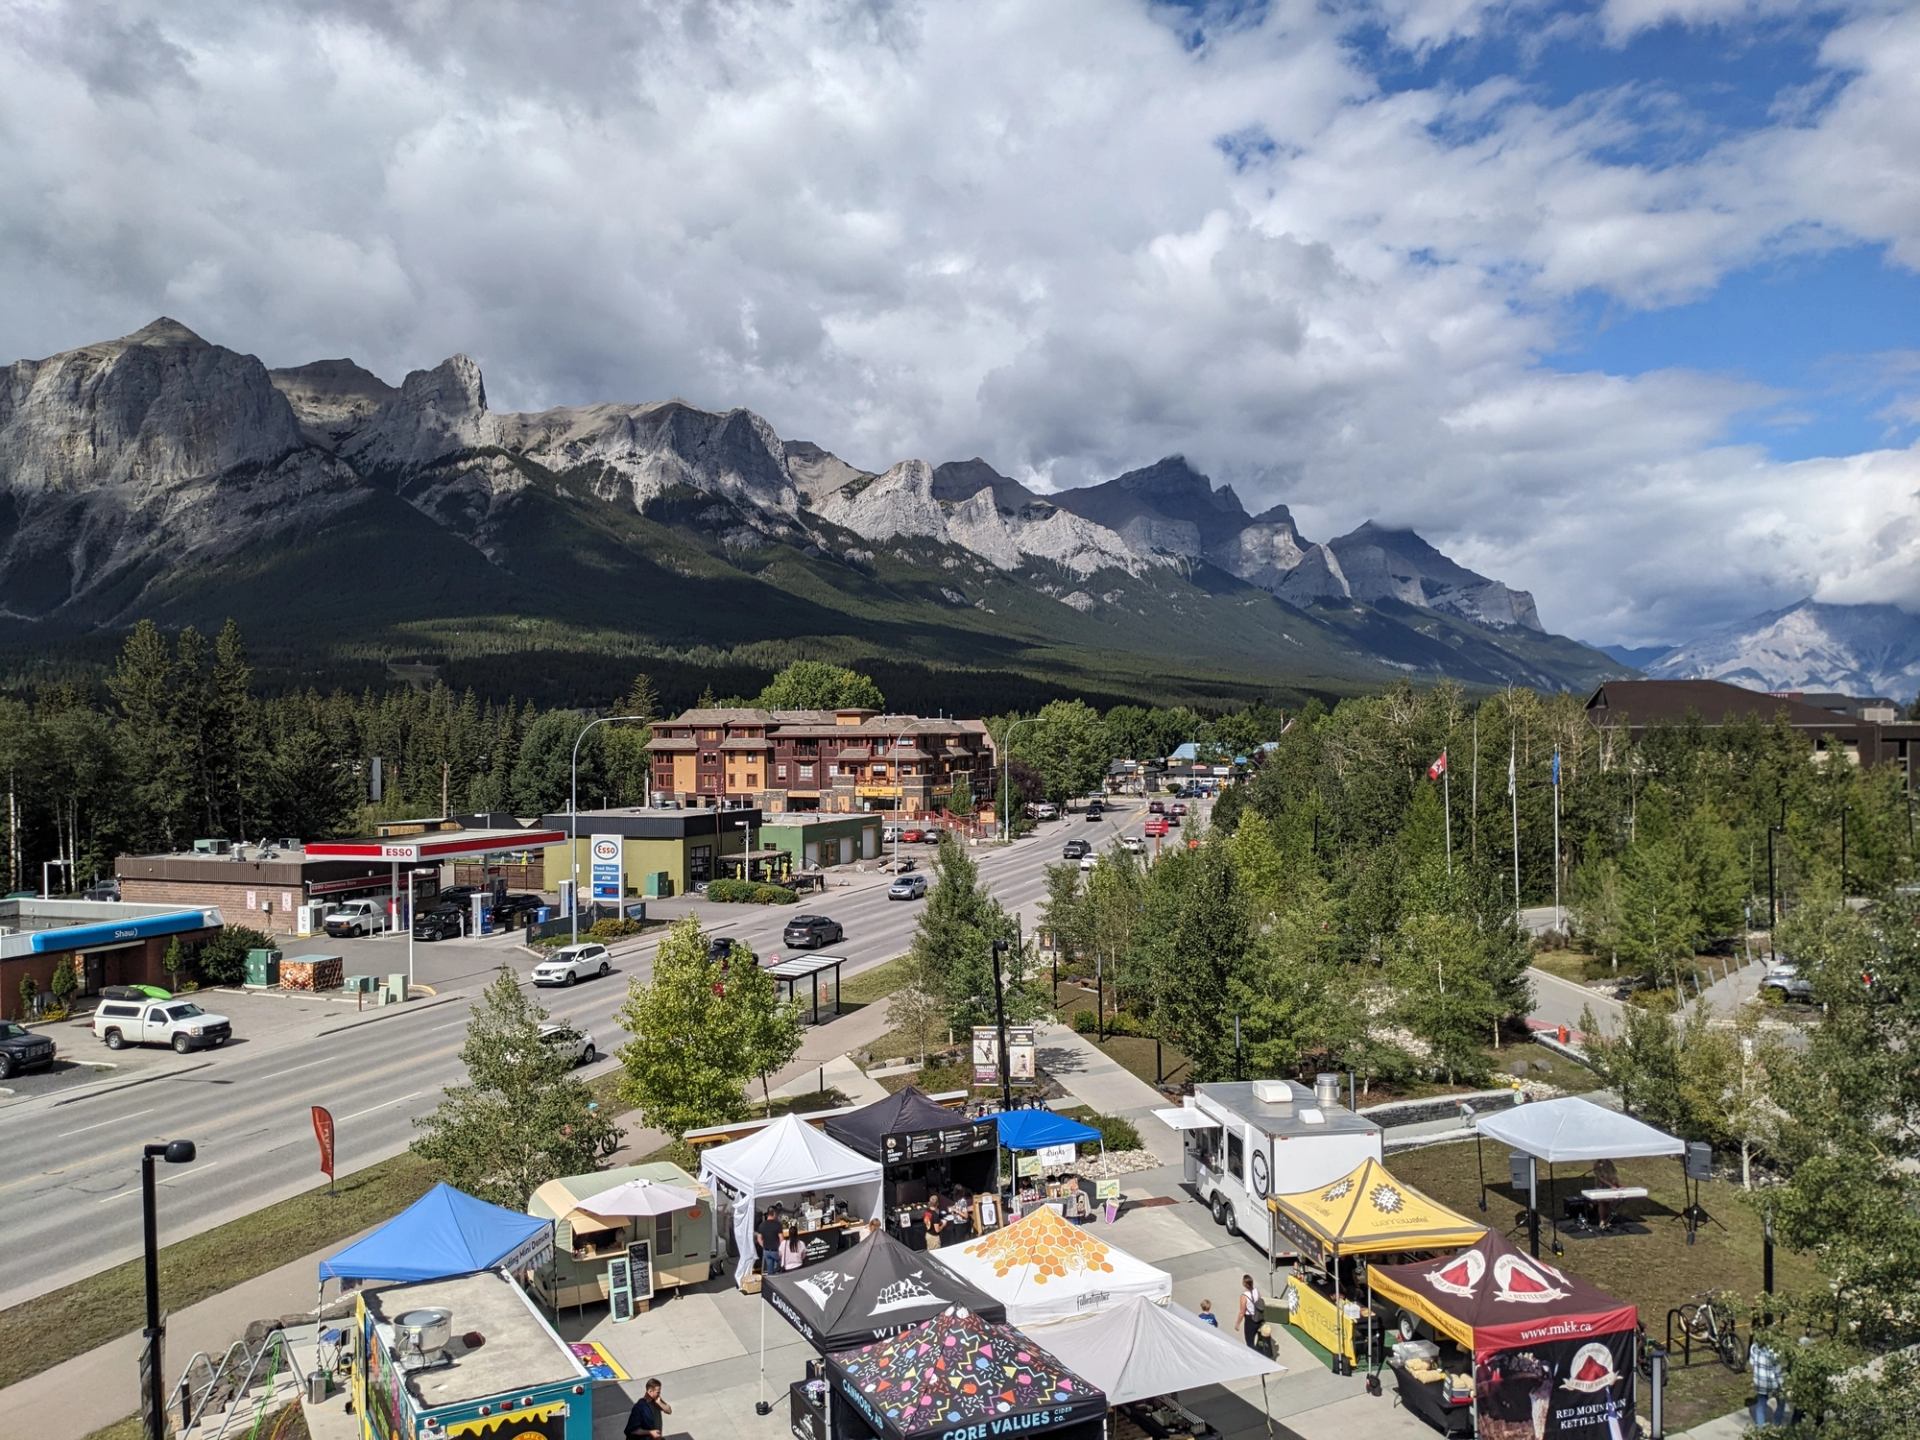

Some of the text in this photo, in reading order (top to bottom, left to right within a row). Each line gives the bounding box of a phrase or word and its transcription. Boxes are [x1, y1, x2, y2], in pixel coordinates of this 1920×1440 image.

[386, 848, 413, 857] ESSO
[598, 845, 615, 854] Esso
[1521, 1320, 1592, 1340] www.rmkk.ca
[1054, 1406, 1073, 1415] CIDER
[1556, 1408, 1575, 1419] RED
[943, 1411, 1051, 1440] CORE VALUES
[1561, 1415, 1596, 1430] KETTLE
